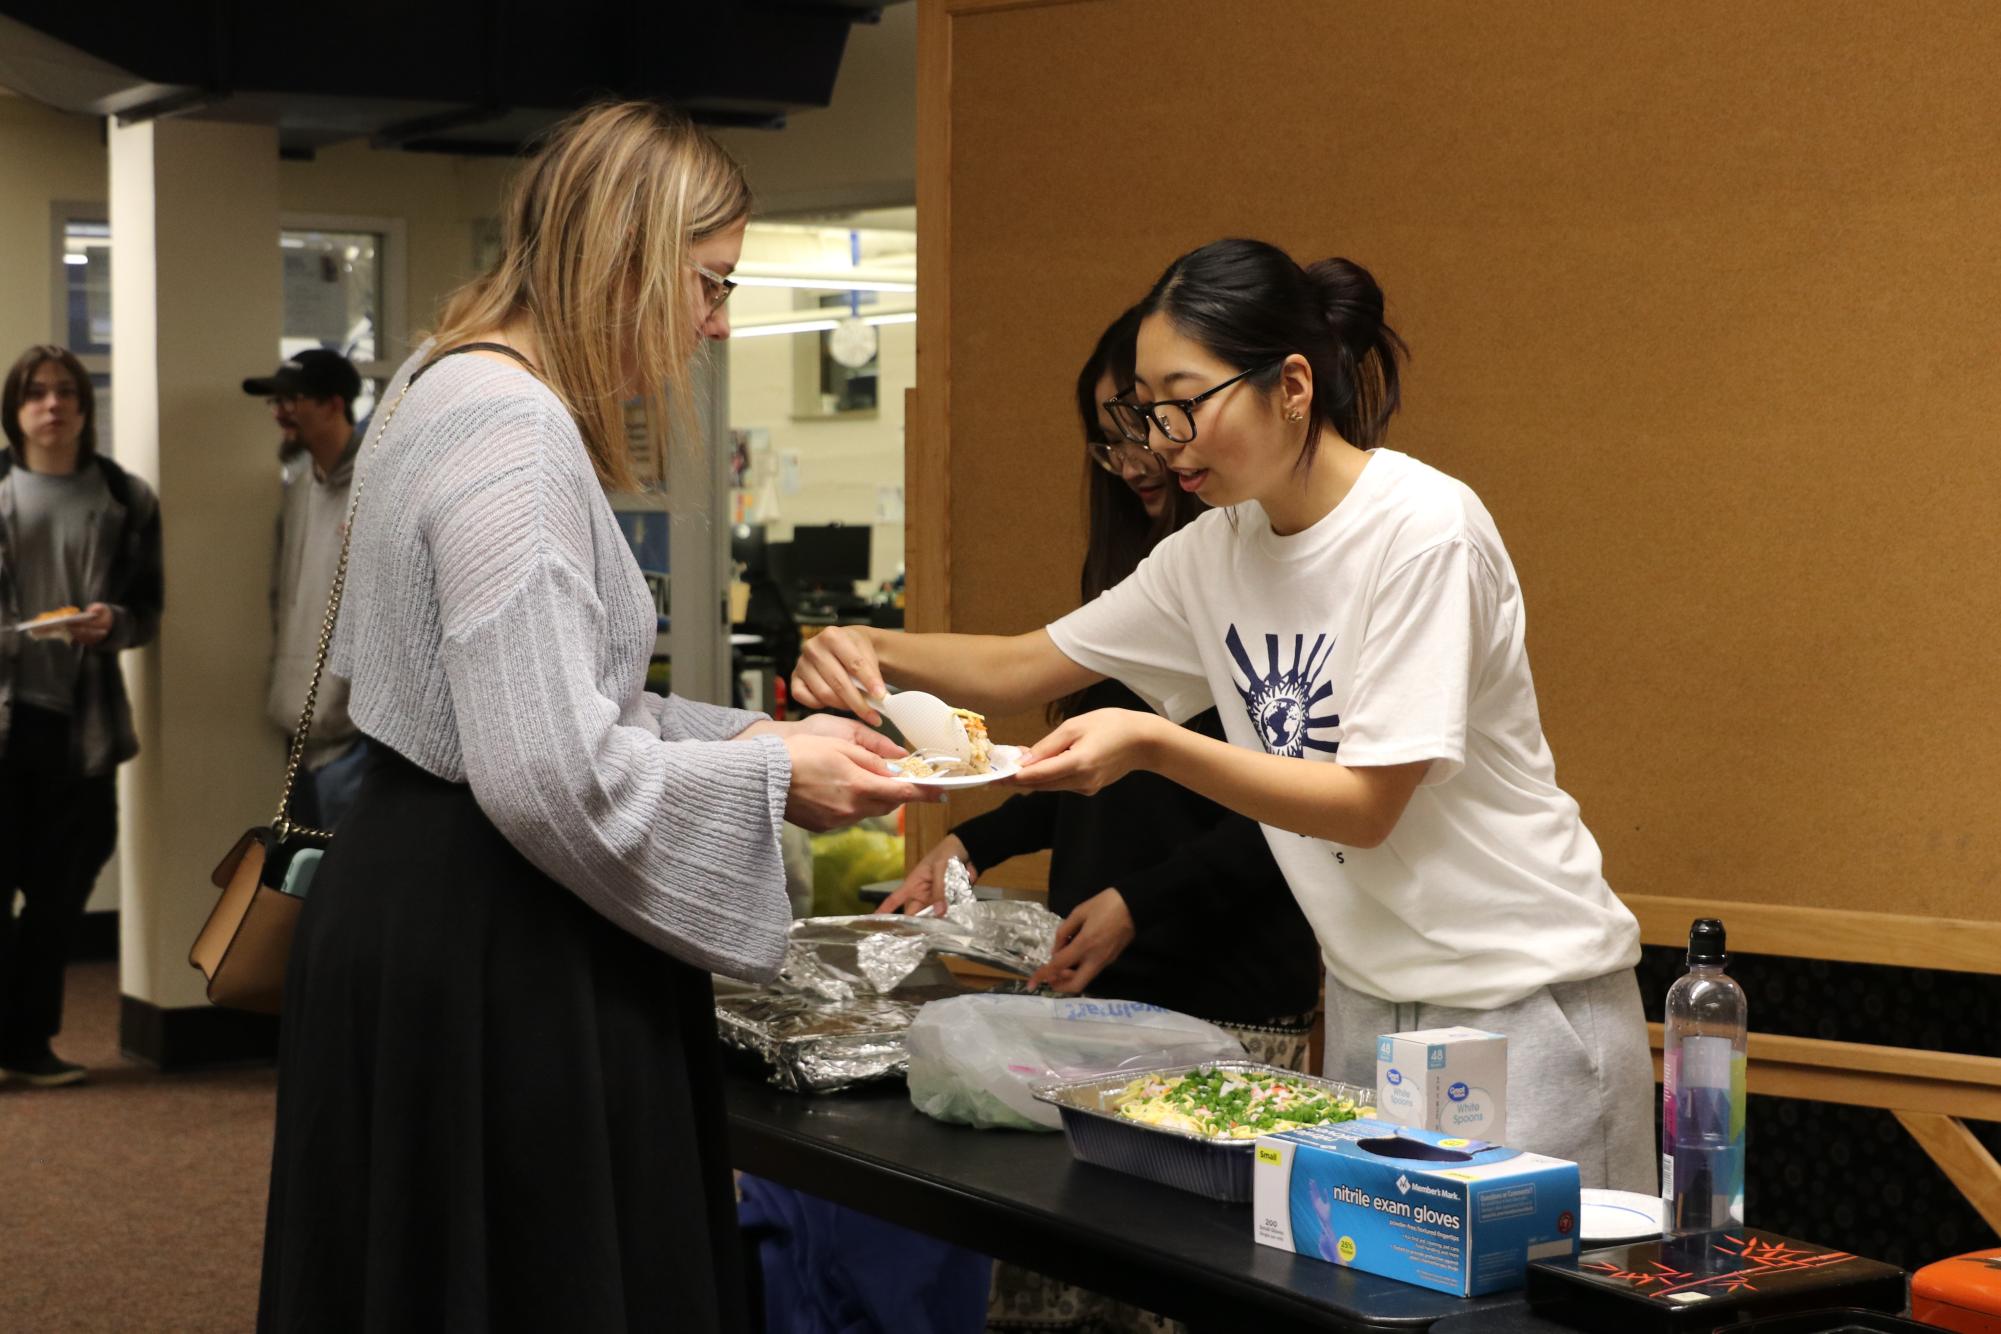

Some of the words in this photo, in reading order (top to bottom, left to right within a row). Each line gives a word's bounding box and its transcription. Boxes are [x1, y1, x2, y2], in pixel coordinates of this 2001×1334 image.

[1380, 1041, 1391, 1055] 48
[1431, 1049, 1444, 1061] 48
[1457, 1103, 1480, 1113] White
[1453, 1113, 1484, 1125] Spoons
[1260, 1150, 1277, 1161] Small
[1411, 1182, 1442, 1197] Member's
[1333, 1184, 1371, 1208] nitrile
[1373, 1196, 1411, 1218] exam
[1413, 1204, 1460, 1230] gloves
